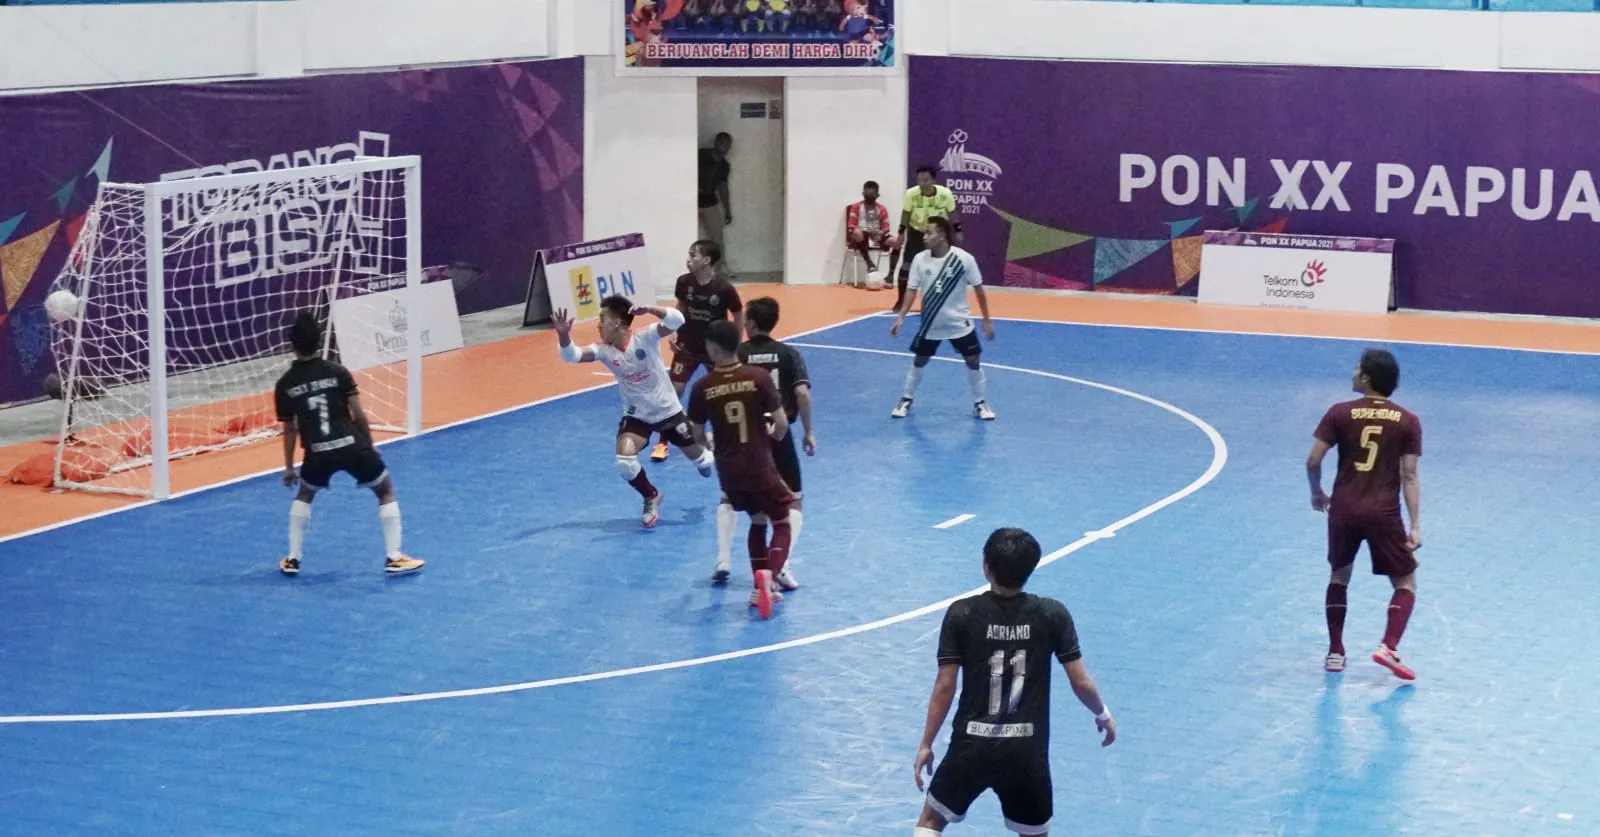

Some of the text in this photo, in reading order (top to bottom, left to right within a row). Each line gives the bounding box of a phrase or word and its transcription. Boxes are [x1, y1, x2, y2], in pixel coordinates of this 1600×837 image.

[647, 43, 874, 58] BERJUANGLAH DEMI HARGA DIRI
[946, 179, 993, 192] PON XX
[1119, 153, 1600, 222] PON XX PAPUA
[961, 204, 980, 214] 2021
[1260, 236, 1278, 246] PON
[1278, 237, 1290, 247] XX
[1290, 238, 1318, 248] PAPUA
[1318, 240, 1334, 249] 2021
[1263, 274, 1299, 287] Telkom
[1266, 287, 1315, 300] Indonesia
[724, 401, 748, 443] 9
[1350, 407, 1402, 422] SUHENDAR
[1353, 425, 1383, 472] 5
[986, 624, 1031, 640] ADRIANO
[988, 650, 1027, 716] 11
[970, 723, 1032, 736] BLACKPINK
